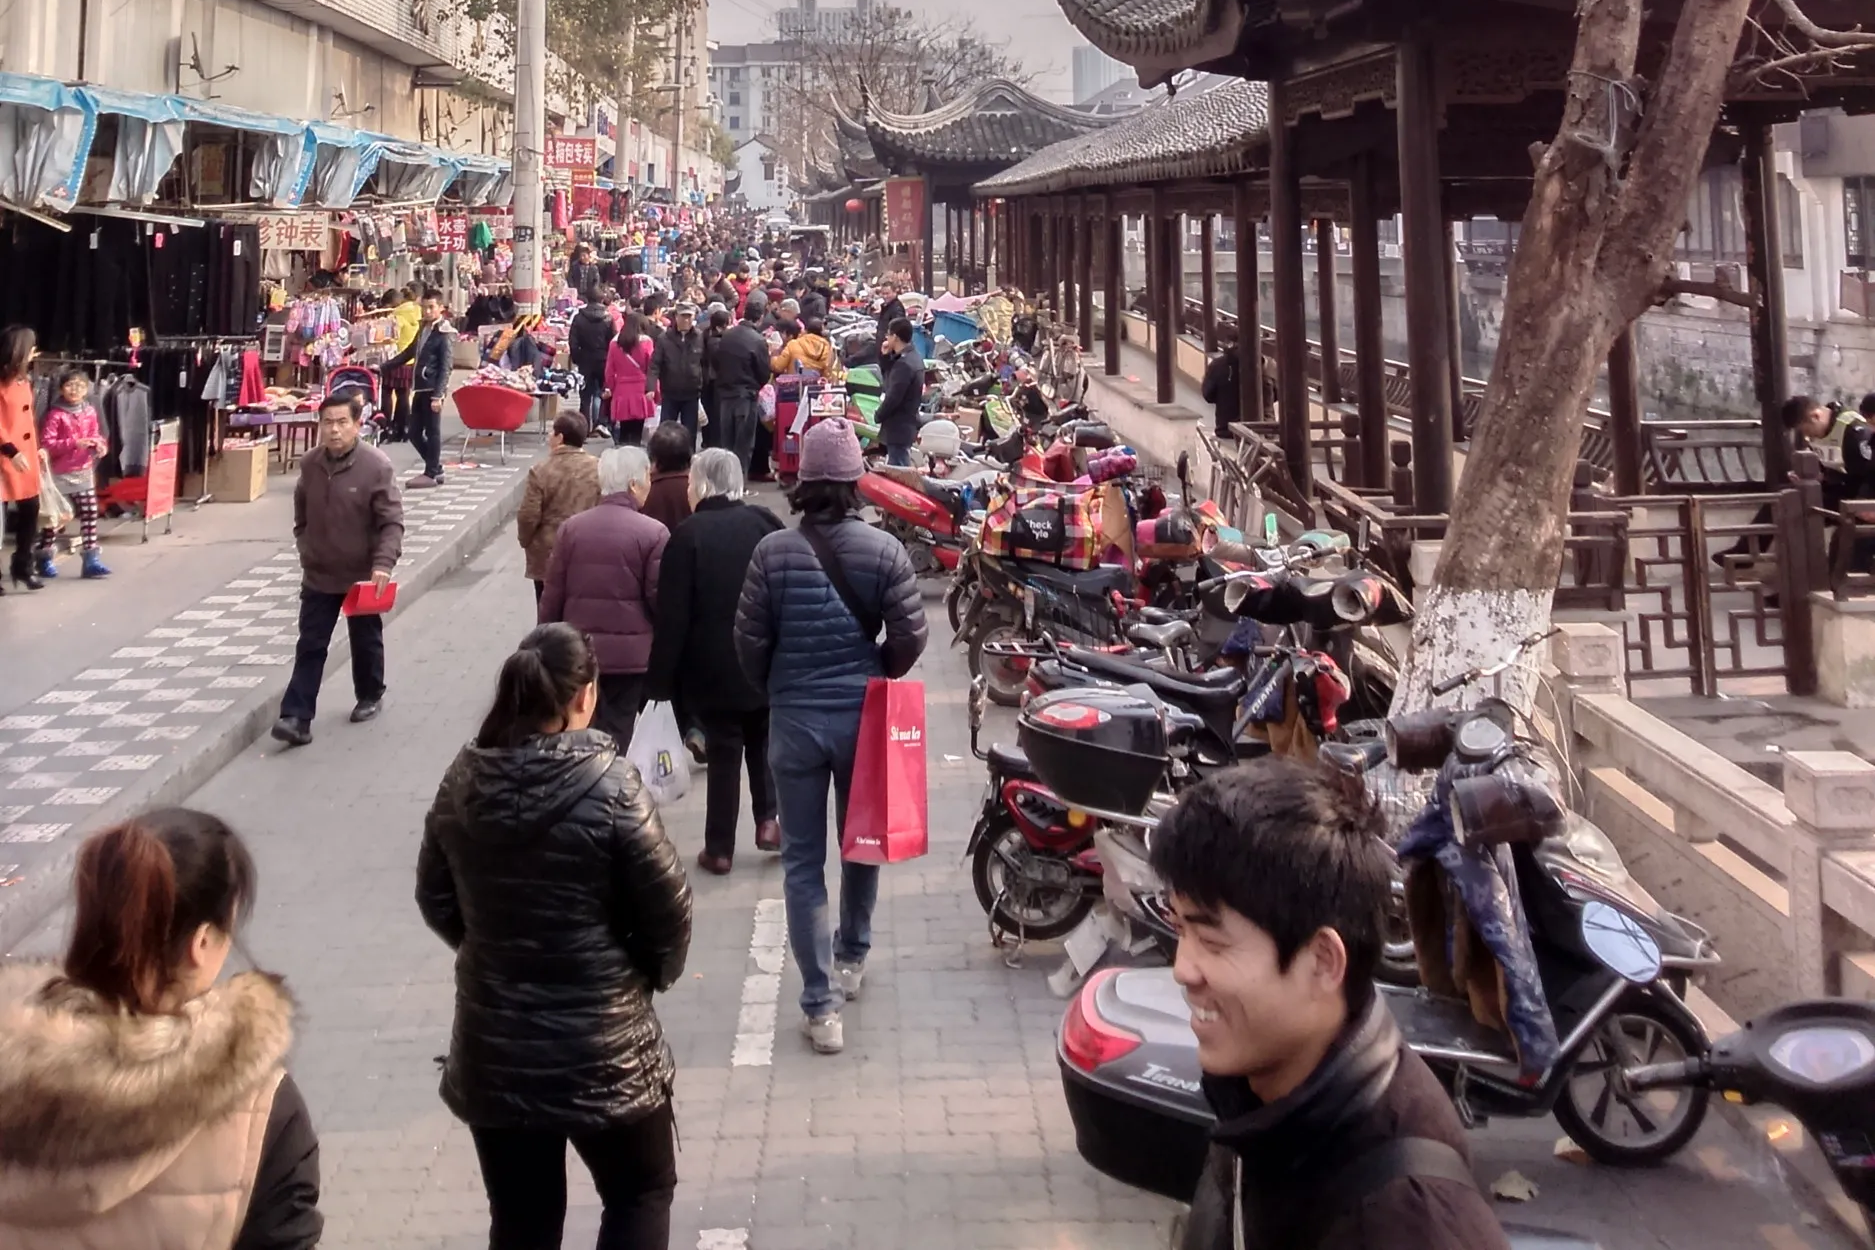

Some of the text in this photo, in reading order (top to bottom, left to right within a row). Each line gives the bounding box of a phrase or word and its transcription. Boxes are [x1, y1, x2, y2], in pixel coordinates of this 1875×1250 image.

[257, 216, 323, 248] 修钟表
[1026, 519, 1052, 530] heck
[1251, 676, 1277, 714] GIANT
